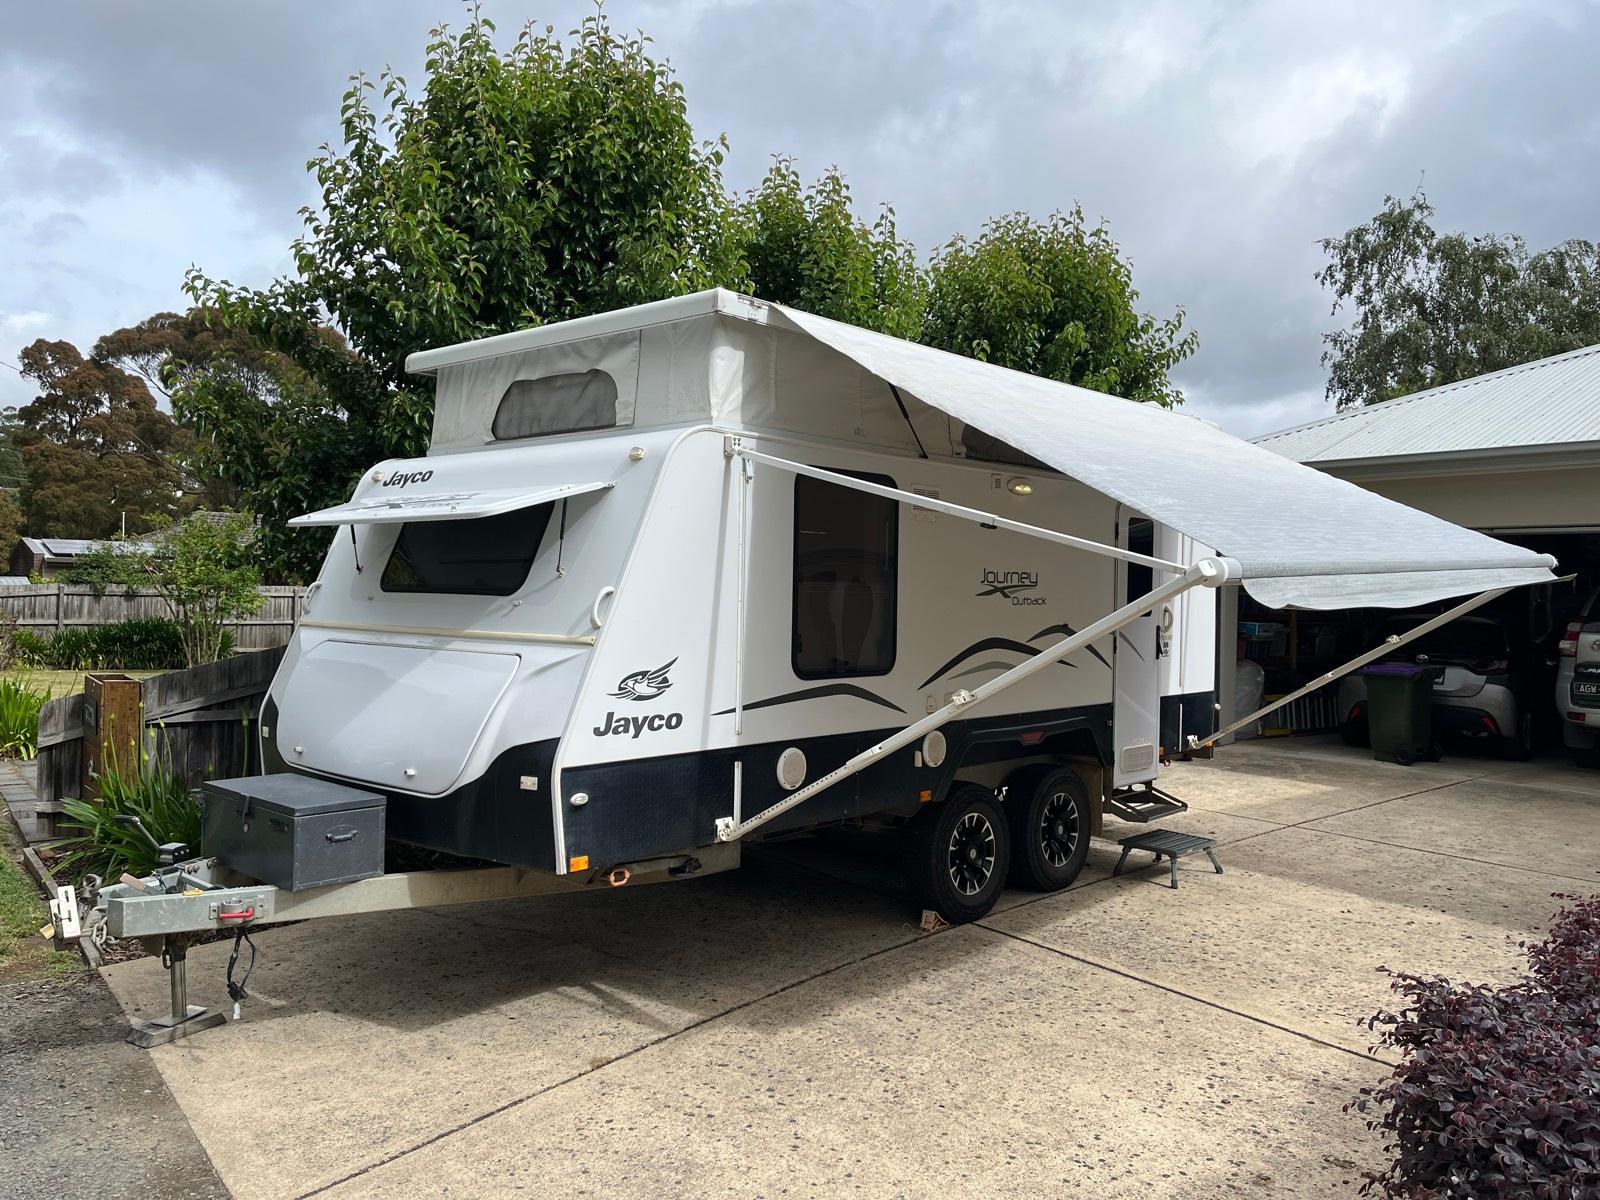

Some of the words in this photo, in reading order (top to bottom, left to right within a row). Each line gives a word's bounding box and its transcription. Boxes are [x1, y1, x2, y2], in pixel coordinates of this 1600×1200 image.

[383, 470, 434, 488] Jayco
[981, 568, 1038, 587] Journey
[1012, 596, 1047, 606] Outback
[593, 711, 683, 739] Jayco
